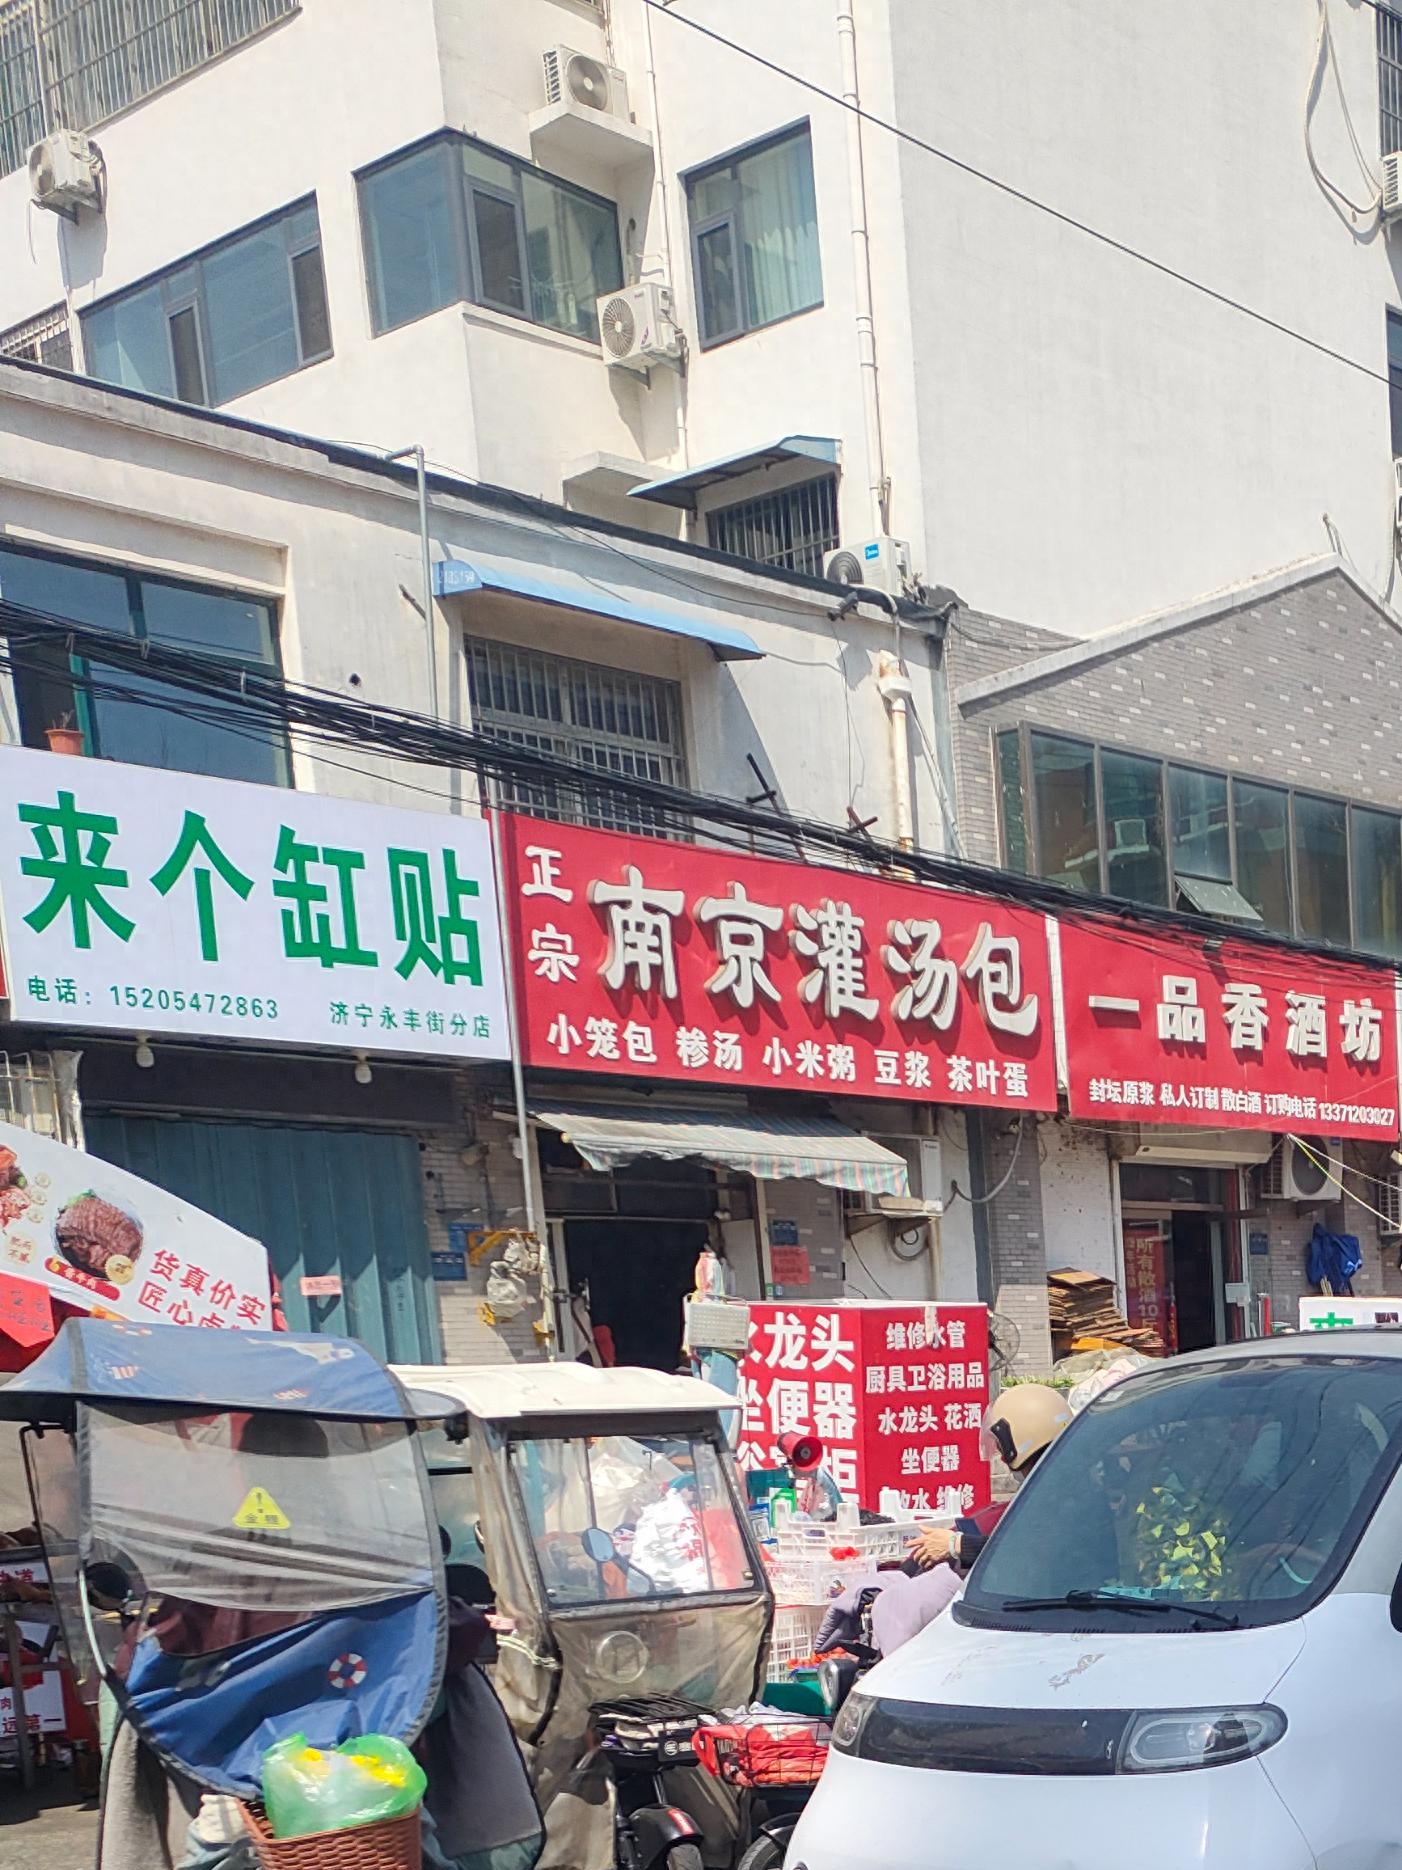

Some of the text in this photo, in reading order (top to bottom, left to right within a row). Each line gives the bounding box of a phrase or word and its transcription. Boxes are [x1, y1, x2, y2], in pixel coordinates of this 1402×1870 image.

[17, 790, 484, 987] 来个缸贴
[521, 845, 580, 983] 正宗
[586, 864, 1039, 1037] 南京灌汤包
[109, 984, 279, 1020] 15205472863
[329, 1001, 491, 1039] 济宁永丰街分店
[1088, 975, 1384, 1062] 一品香酒坊
[546, 1013, 658, 1064] 小笼包
[762, 1037, 857, 1082] 小米粥
[874, 1049, 932, 1089] 豆浆
[946, 1055, 1030, 1098] 茶叶蛋
[1089, 1078, 1156, 1106] 封坛原浆
[1159, 1082, 1220, 1111] 私人订制
[1221, 1086, 1262, 1116] 散白酒
[1264, 1093, 1317, 1120] 订购电话
[147, 1248, 266, 1325] 货真价实
[865, 1361, 986, 1394] 厨具卫浴用品
[877, 1402, 983, 1436] 水龙头 花洒
[900, 1444, 961, 1475] 坐便器
